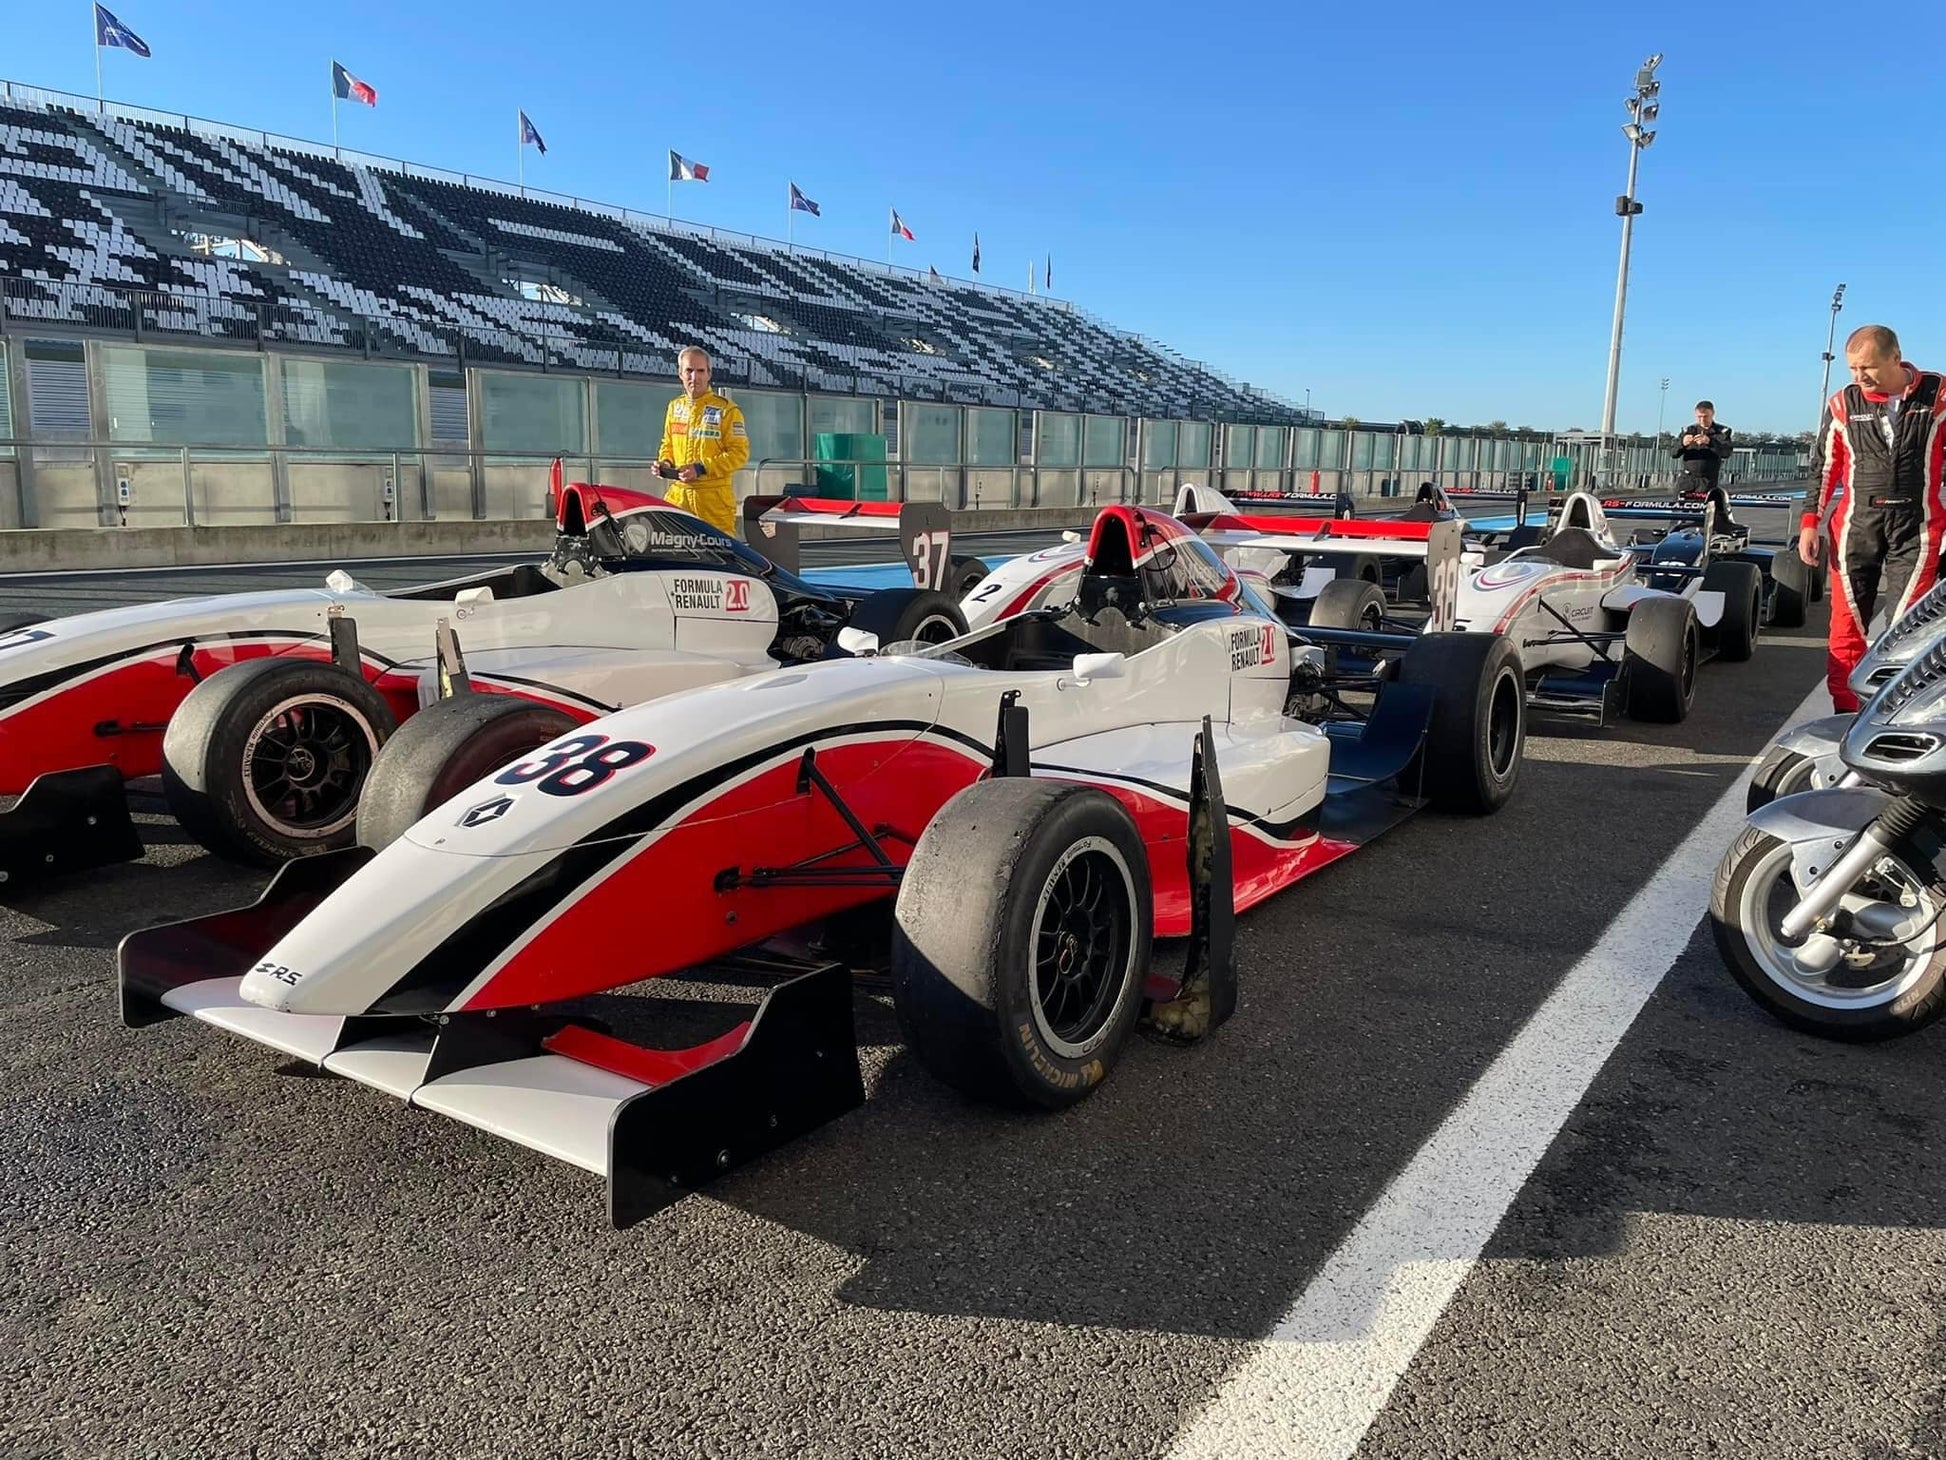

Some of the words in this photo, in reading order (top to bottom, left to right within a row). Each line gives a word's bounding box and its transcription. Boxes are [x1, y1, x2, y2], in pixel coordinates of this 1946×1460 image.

[1603, 500, 1708, 509] RS-FORMULA.COM
[651, 531, 732, 548] Magny-Cours
[912, 531, 949, 592] 37
[674, 579, 723, 594] FORMULA
[726, 581, 750, 611] 2.0
[676, 595, 721, 609] RENAULT
[971, 584, 1003, 603] 2
[1231, 627, 1260, 651] FORMULA
[1231, 647, 1260, 672] RENAULT
[494, 735, 656, 797] 38
[1019, 1023, 1079, 1088] MICHELIN
